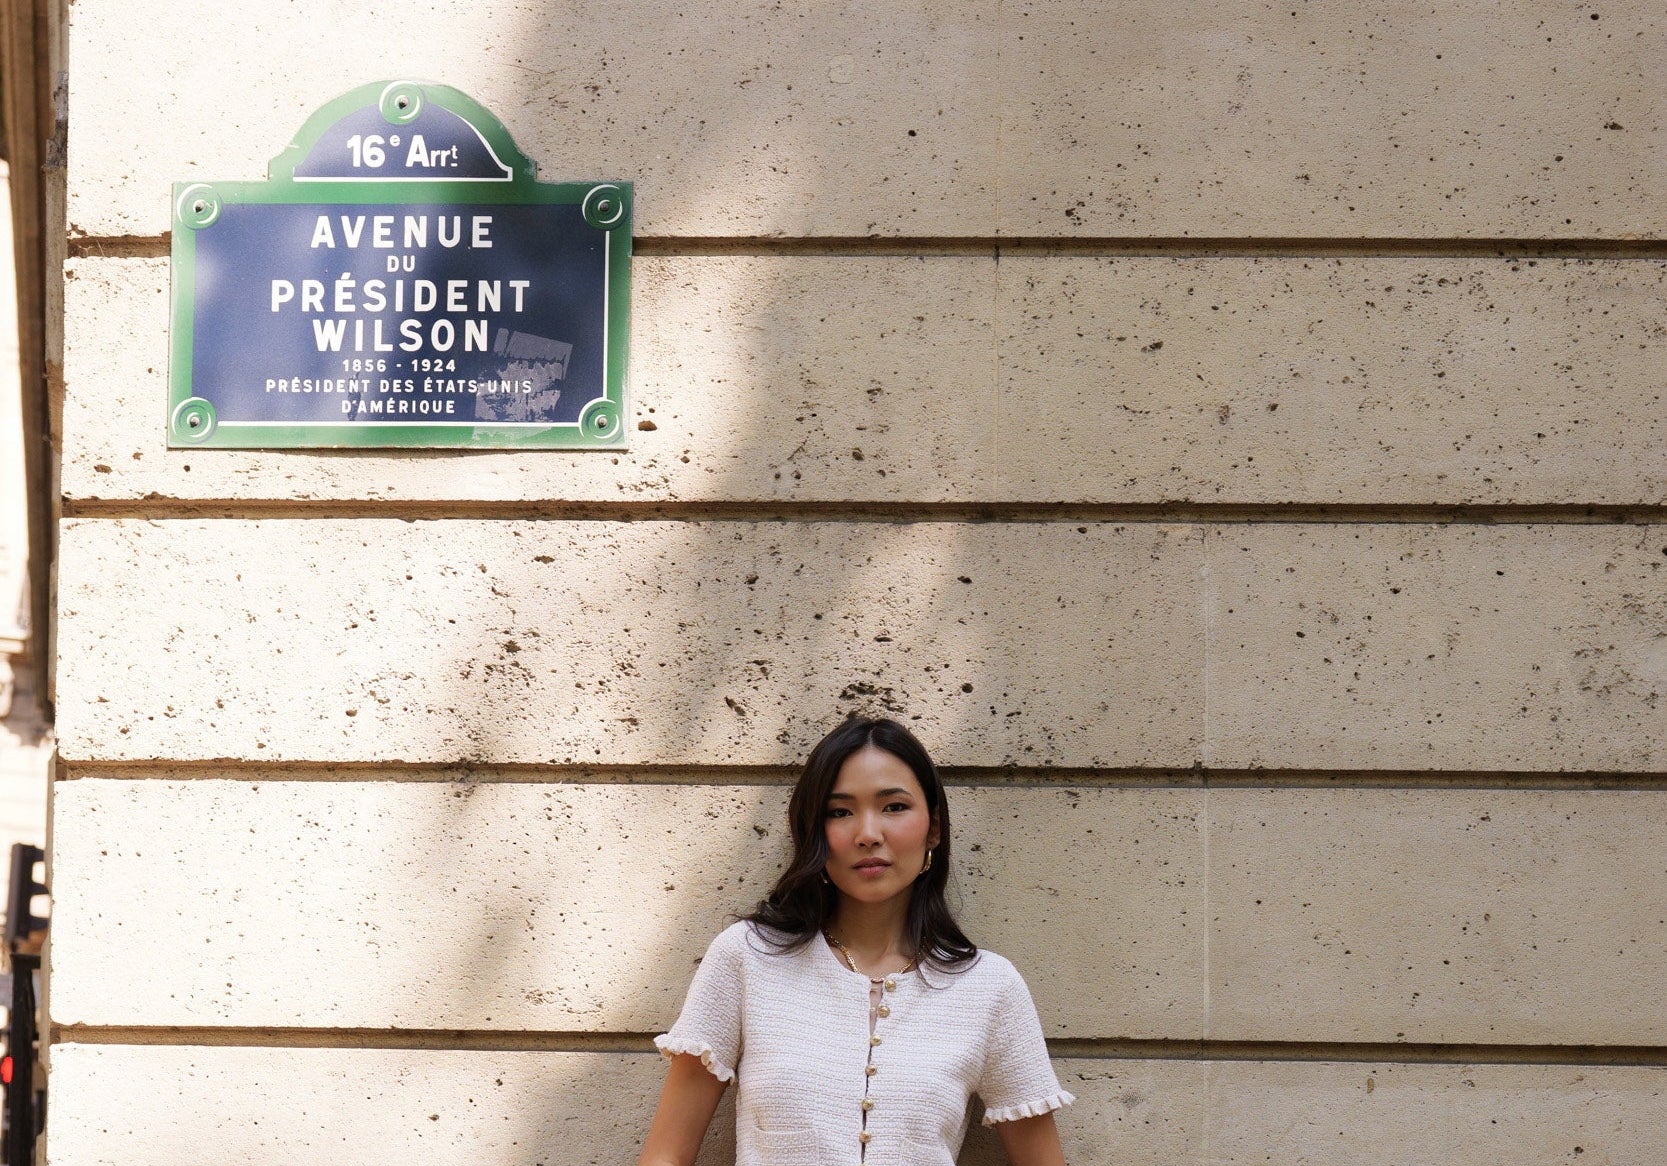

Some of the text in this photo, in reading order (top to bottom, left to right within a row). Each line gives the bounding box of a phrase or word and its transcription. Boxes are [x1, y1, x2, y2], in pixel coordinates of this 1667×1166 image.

[310, 215, 493, 249] AVENUE
[386, 255, 416, 273] DU
[271, 272, 530, 312] PRÉSIDENT
[312, 319, 489, 352] WILSON
[343, 358, 387, 373] 1856
[411, 358, 456, 373] 1924
[265, 376, 532, 394] PRÉSIDENT DES ÉTATS-UNIS
[341, 397, 456, 414] D'AMÉRIQUE
